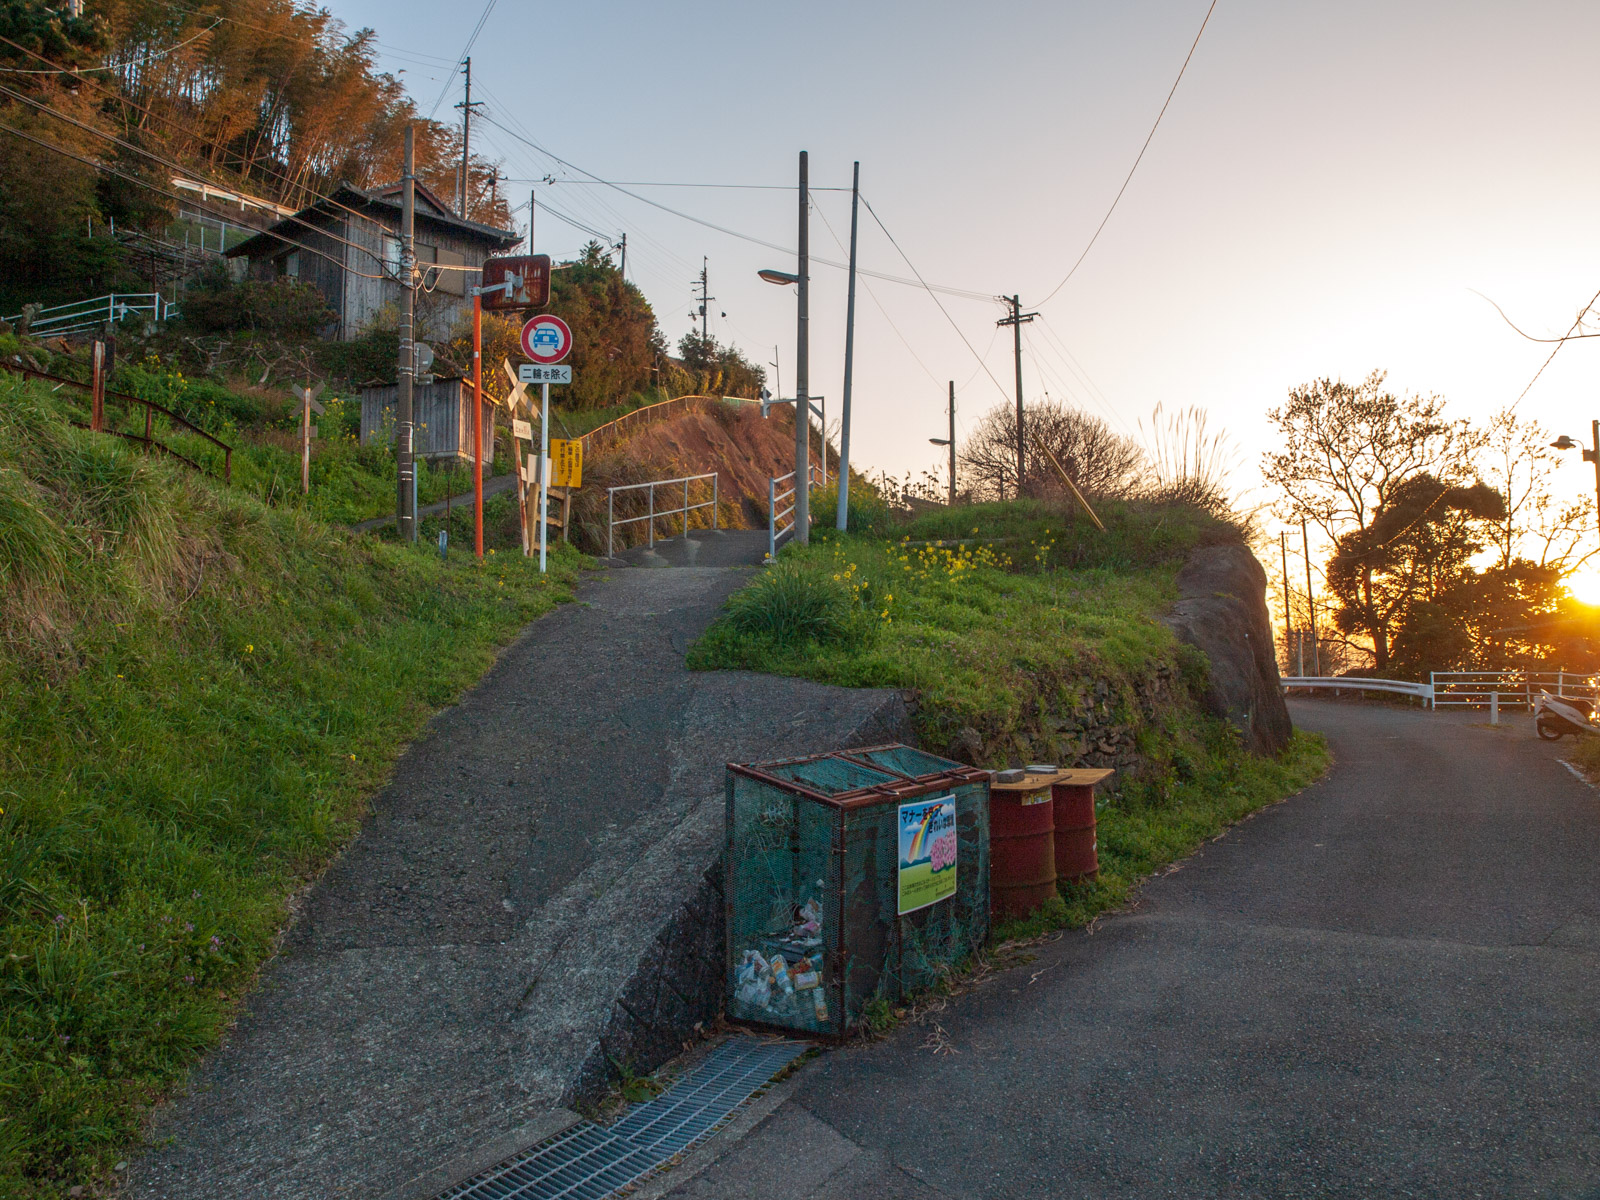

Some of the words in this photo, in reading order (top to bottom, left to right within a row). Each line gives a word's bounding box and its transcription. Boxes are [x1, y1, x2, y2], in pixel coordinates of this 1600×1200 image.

[522, 368, 568, 380] 二輪を除く
